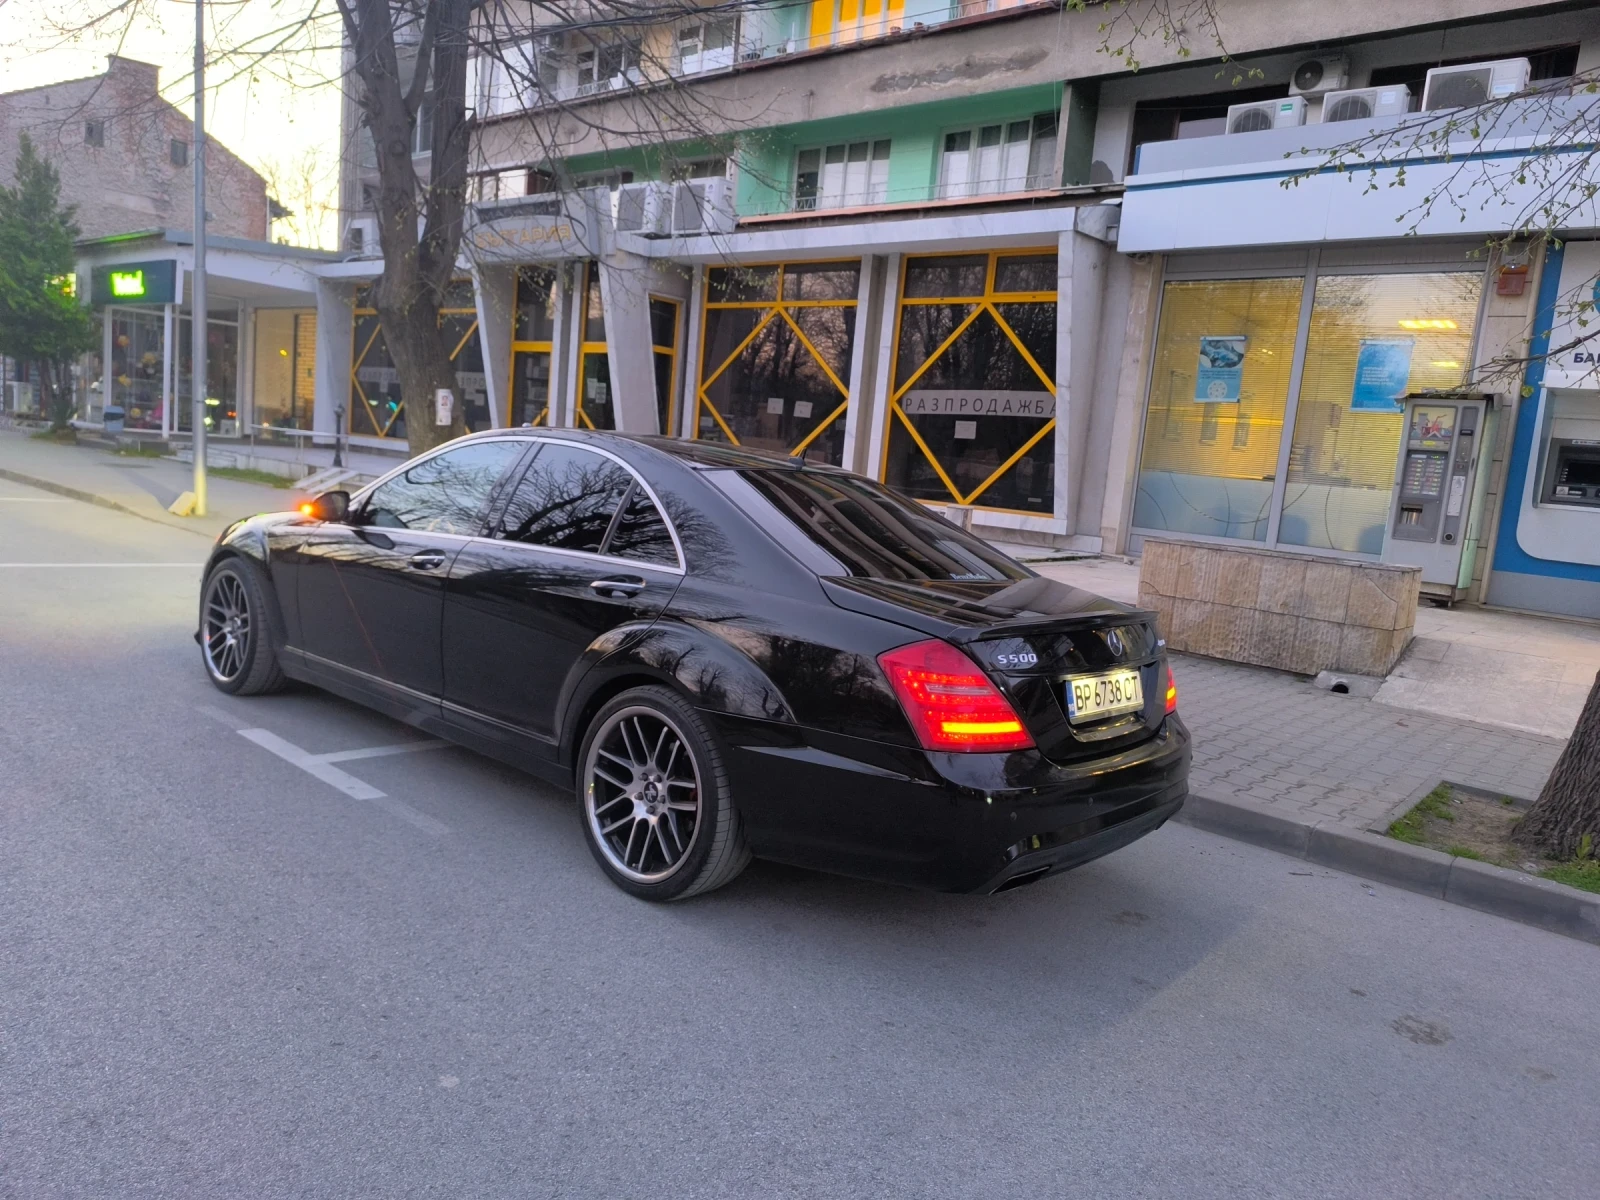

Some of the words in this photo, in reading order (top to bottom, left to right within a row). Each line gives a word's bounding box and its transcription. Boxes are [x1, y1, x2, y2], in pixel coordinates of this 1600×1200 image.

[1573, 353, 1600, 364] БА
[997, 654, 1007, 664] S
[1009, 653, 1037, 663] 500
[1095, 680, 1122, 706] 6738
